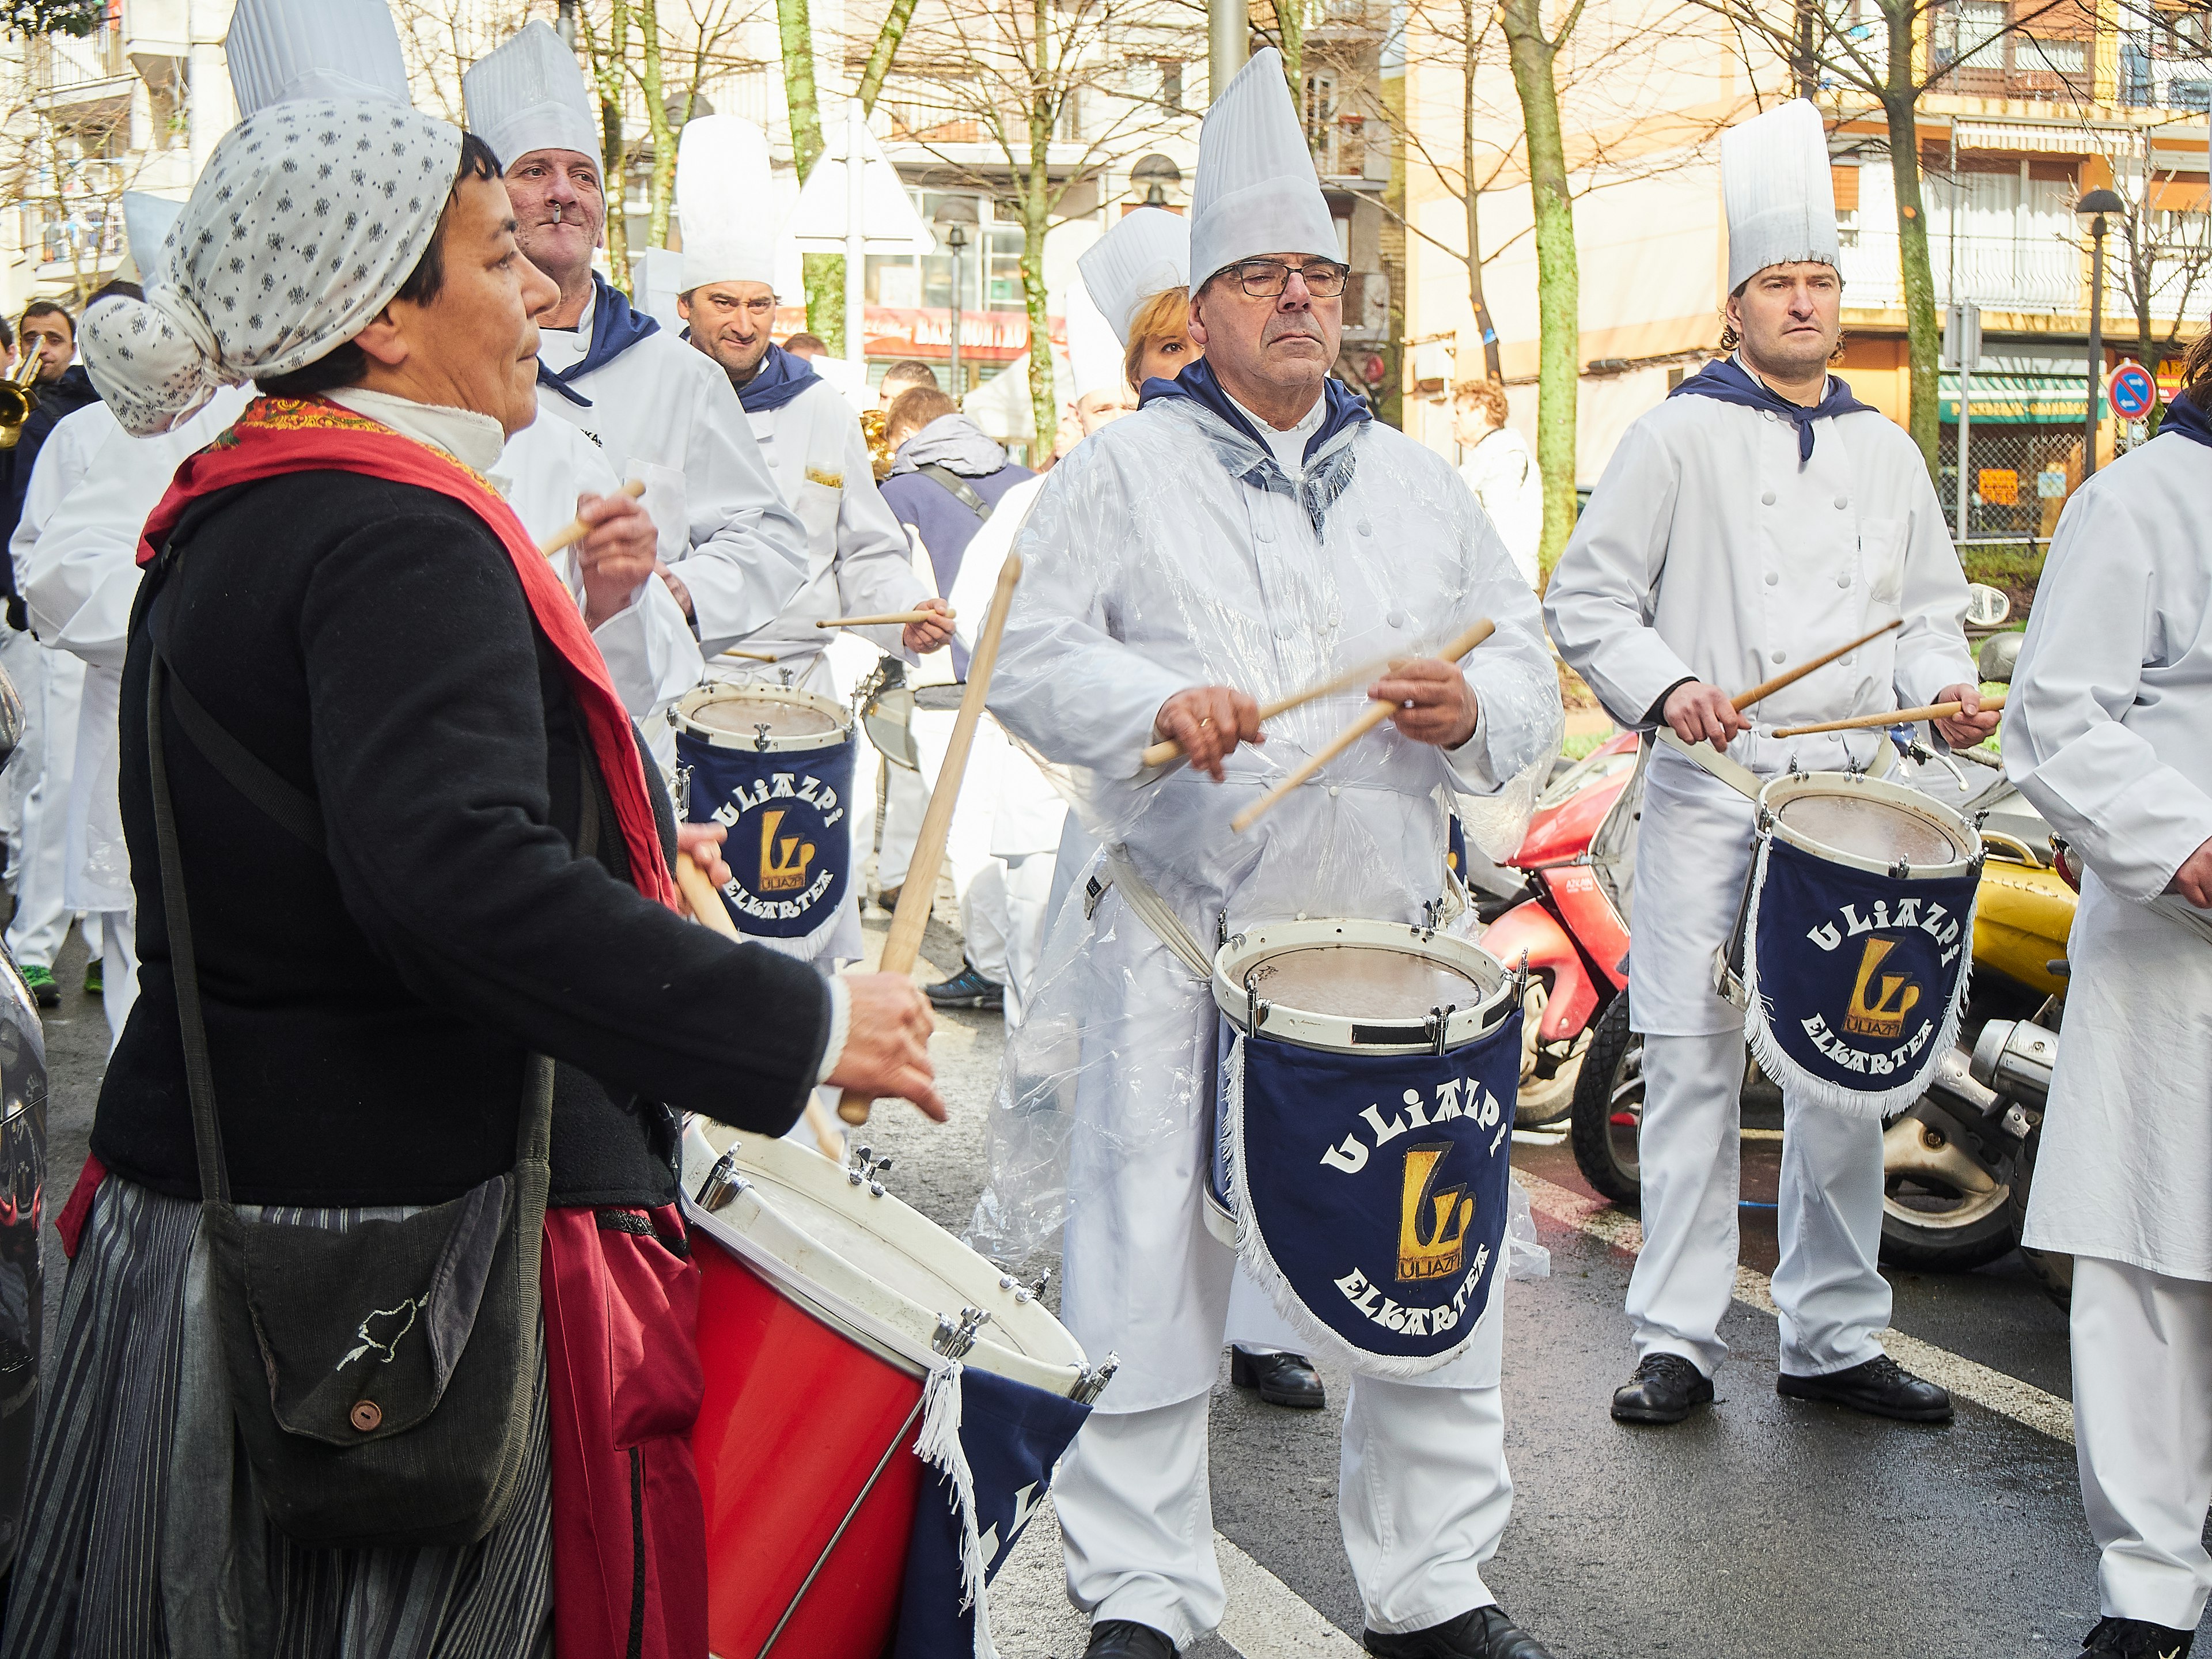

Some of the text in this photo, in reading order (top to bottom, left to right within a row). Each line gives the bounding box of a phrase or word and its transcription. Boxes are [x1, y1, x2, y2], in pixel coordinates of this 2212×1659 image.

[1951, 402, 2025, 416] PNADERIA
[723, 869, 834, 919] ELKARTEA
[1801, 1013, 1934, 1074] ELKARTEA
[1334, 1243, 1490, 1336] ELKARTEA
[1400, 1253, 1461, 1278] ULIAZPI
